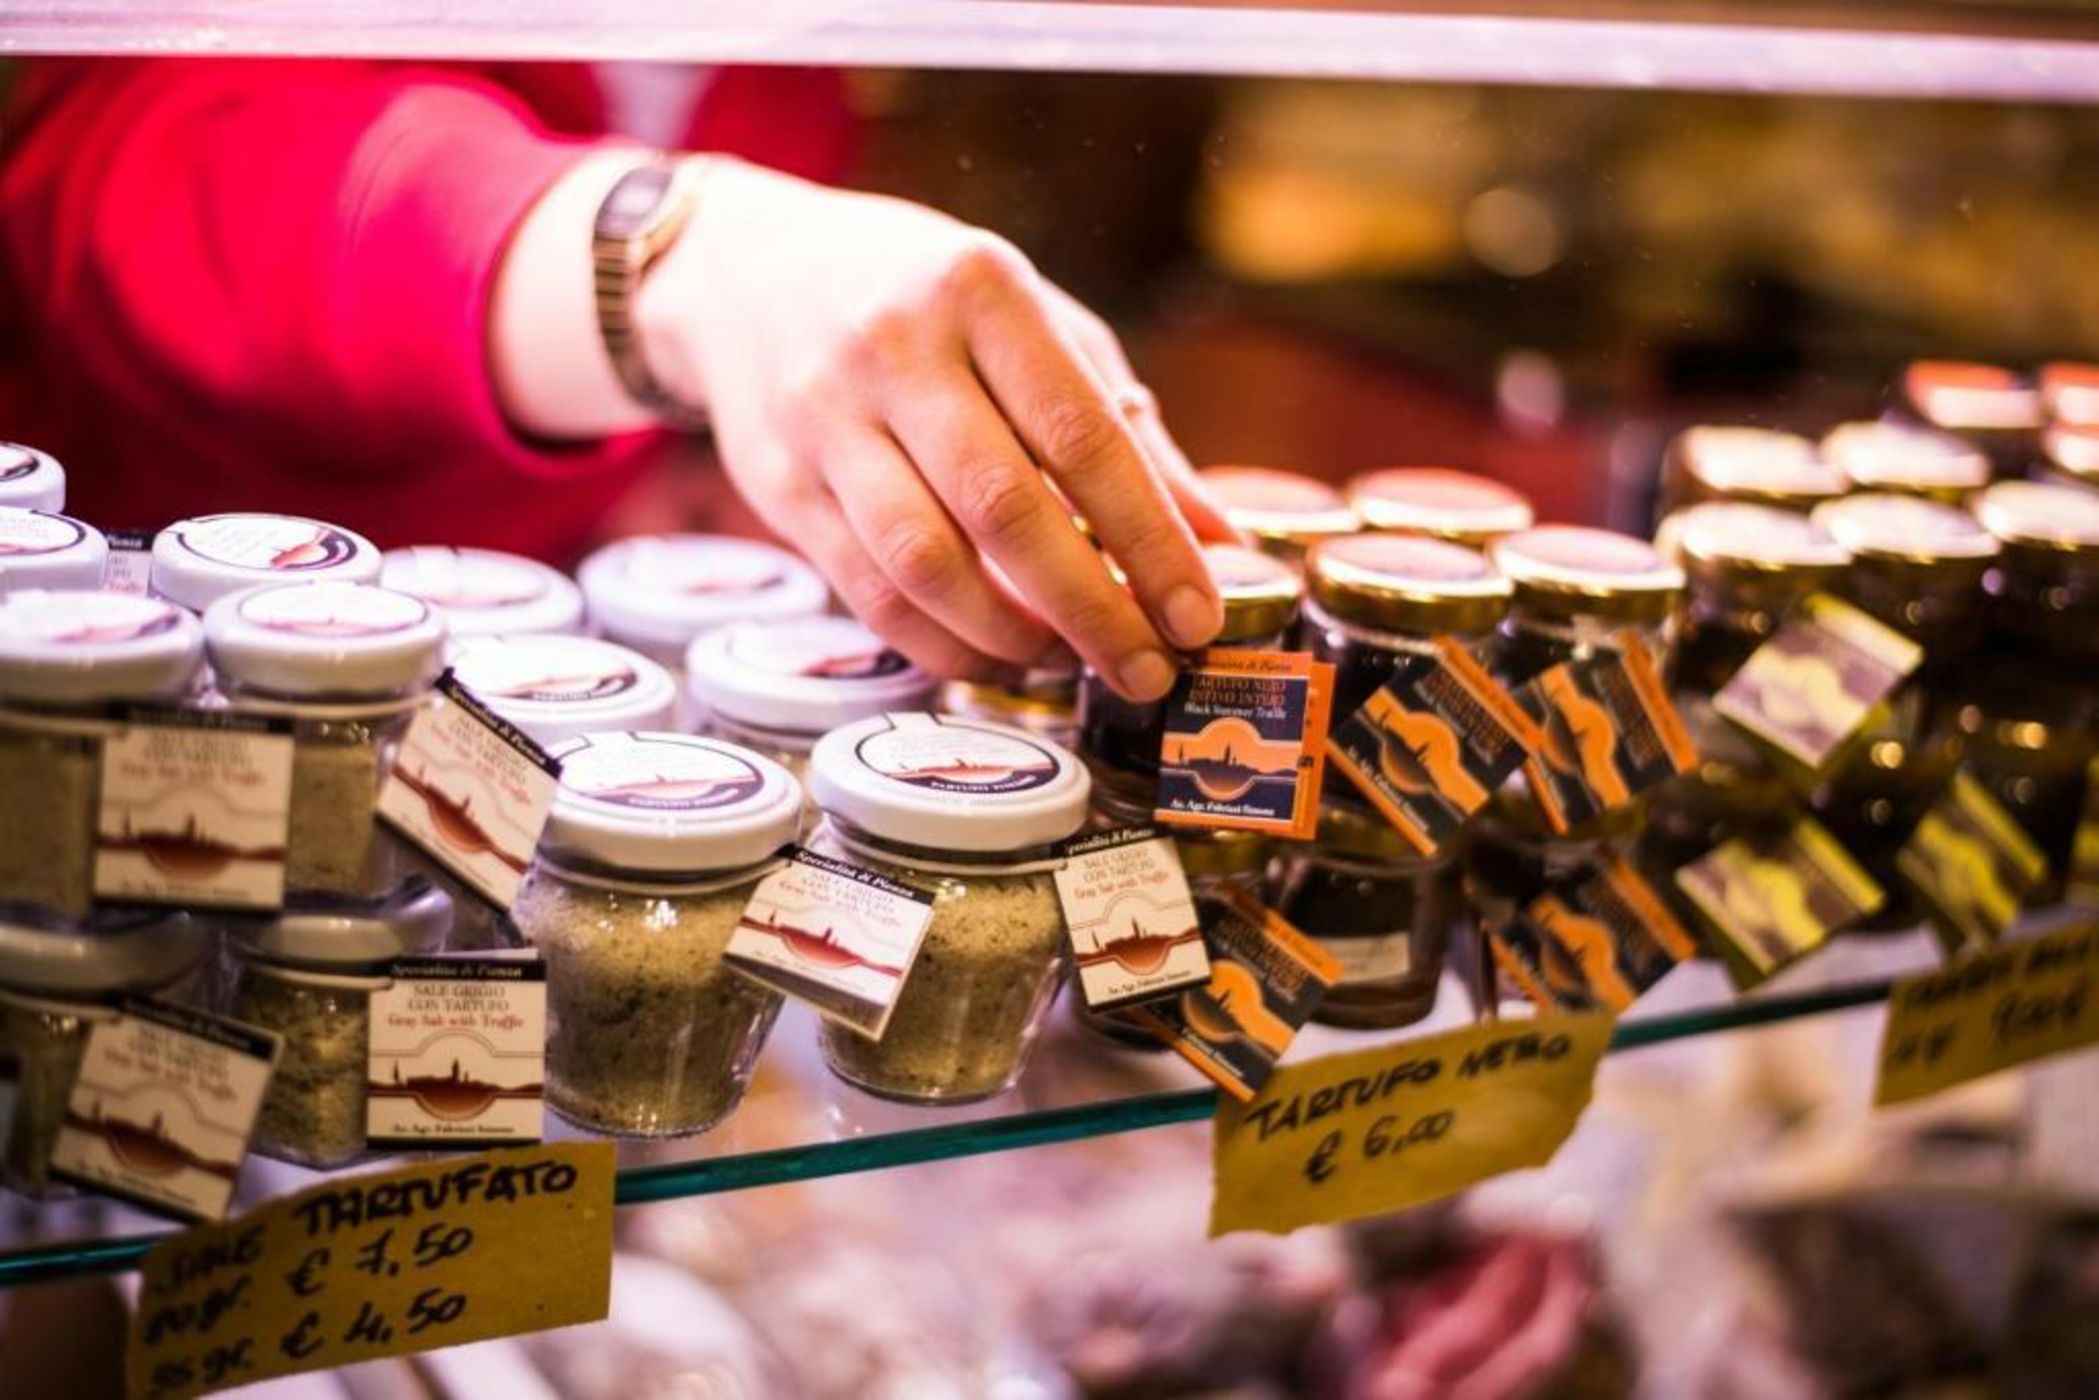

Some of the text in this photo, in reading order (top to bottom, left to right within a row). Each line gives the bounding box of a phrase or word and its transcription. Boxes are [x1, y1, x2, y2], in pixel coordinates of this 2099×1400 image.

[1243, 1032, 1574, 1143] TARTUFO NERO
[1303, 1127, 1344, 1184] €
[300, 1161, 578, 1236] TARTUFATO
[286, 1248, 331, 1297] €
[281, 1313, 326, 1360] €
